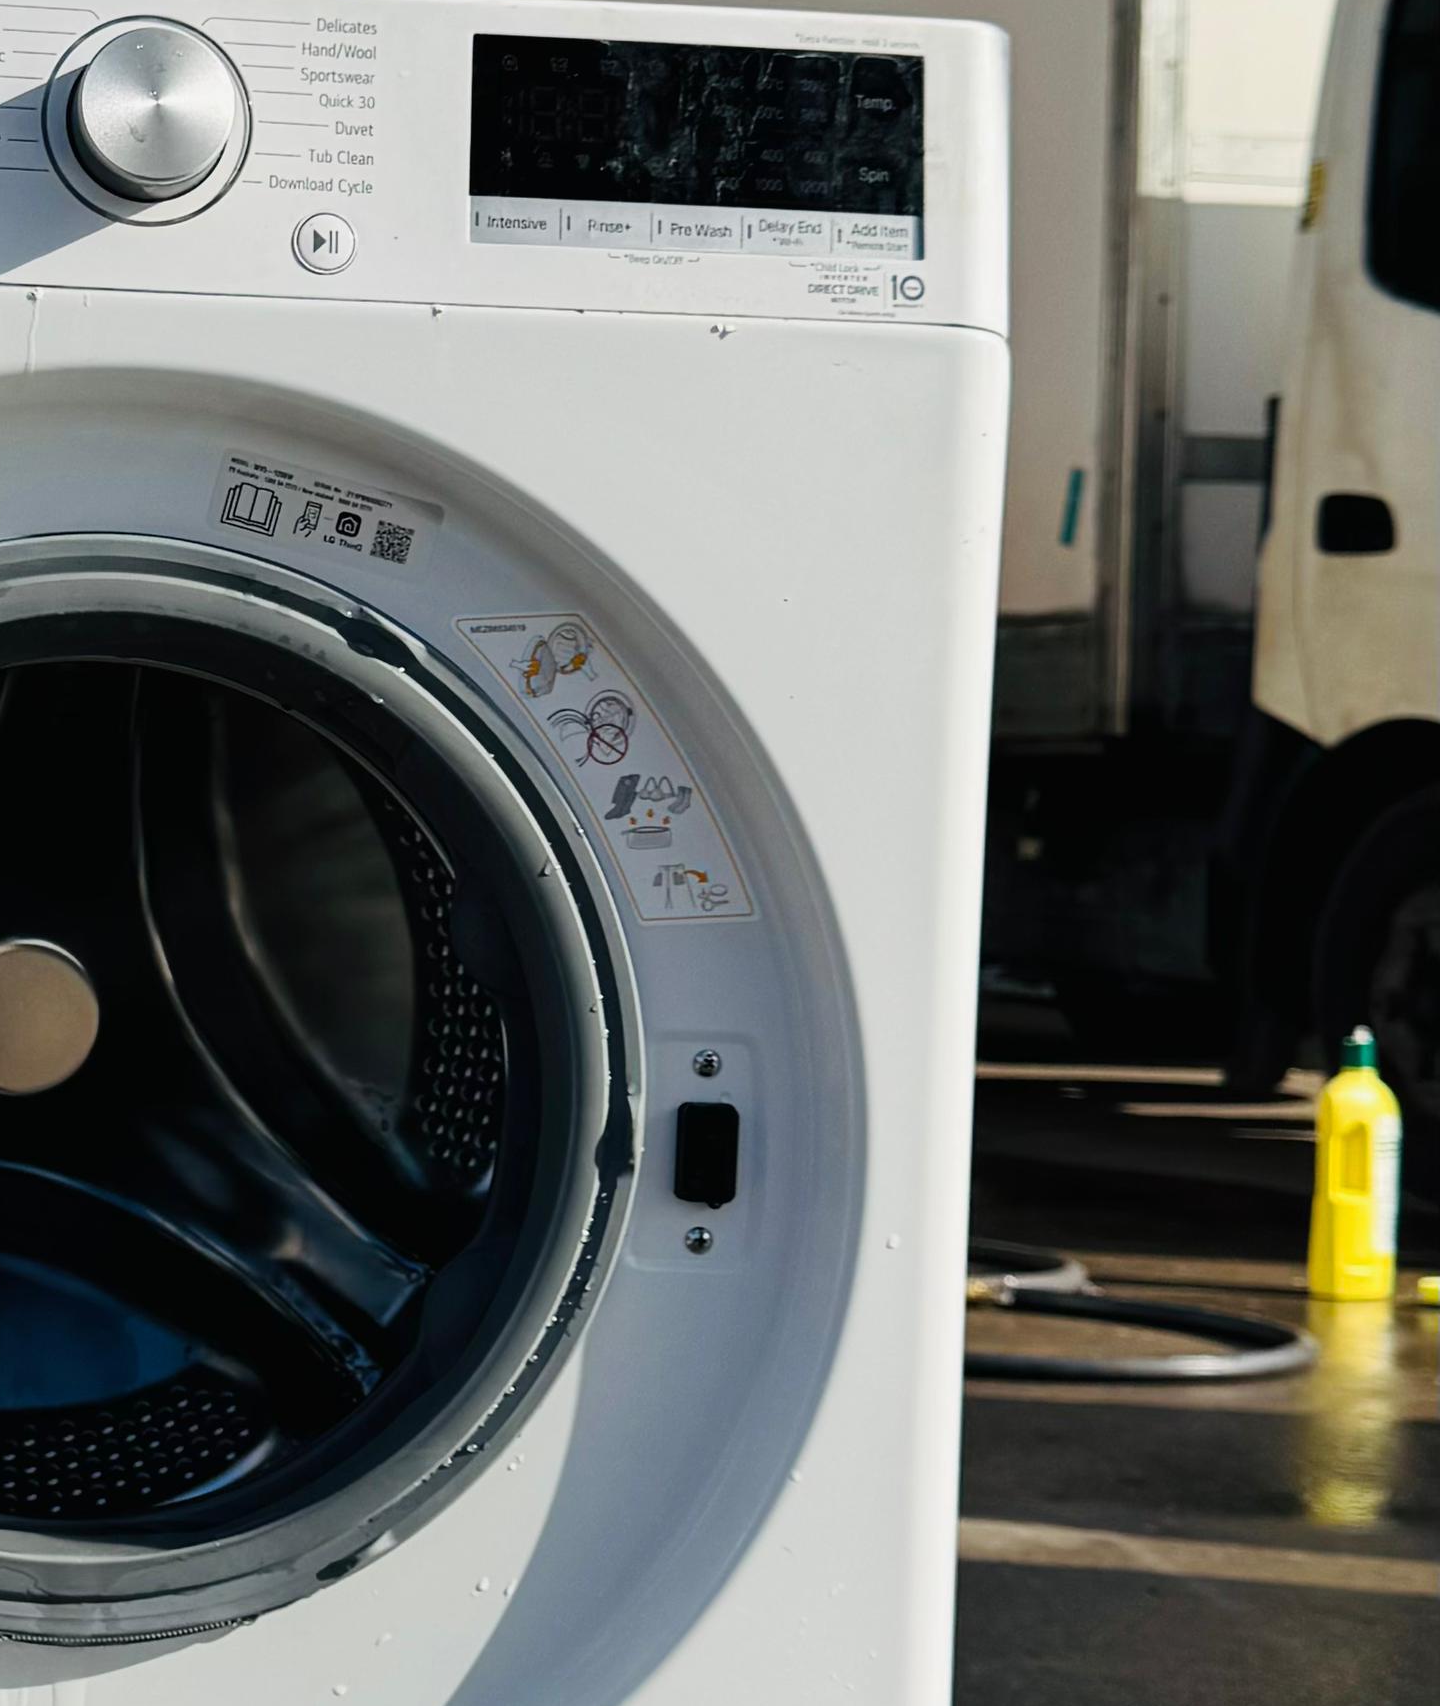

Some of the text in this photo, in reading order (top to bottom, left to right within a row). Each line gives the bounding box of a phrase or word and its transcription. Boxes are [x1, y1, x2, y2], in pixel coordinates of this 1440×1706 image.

[316, 17, 377, 35] Delicates
[301, 42, 377, 60] Hand/Wool
[300, 67, 375, 85] Sportswear
[319, 93, 375, 109] Quick 30
[856, 94, 896, 112] Temp.
[335, 121, 374, 137] Duvet
[309, 148, 374, 166] Tub Clean
[859, 166, 889, 184] Spin
[269, 175, 373, 197] Download Cycle
[487, 215, 547, 231] Intensive
[670, 222, 732, 238] Pre Wash
[759, 219, 822, 235] Delay End
[851, 223, 878, 237] Add
